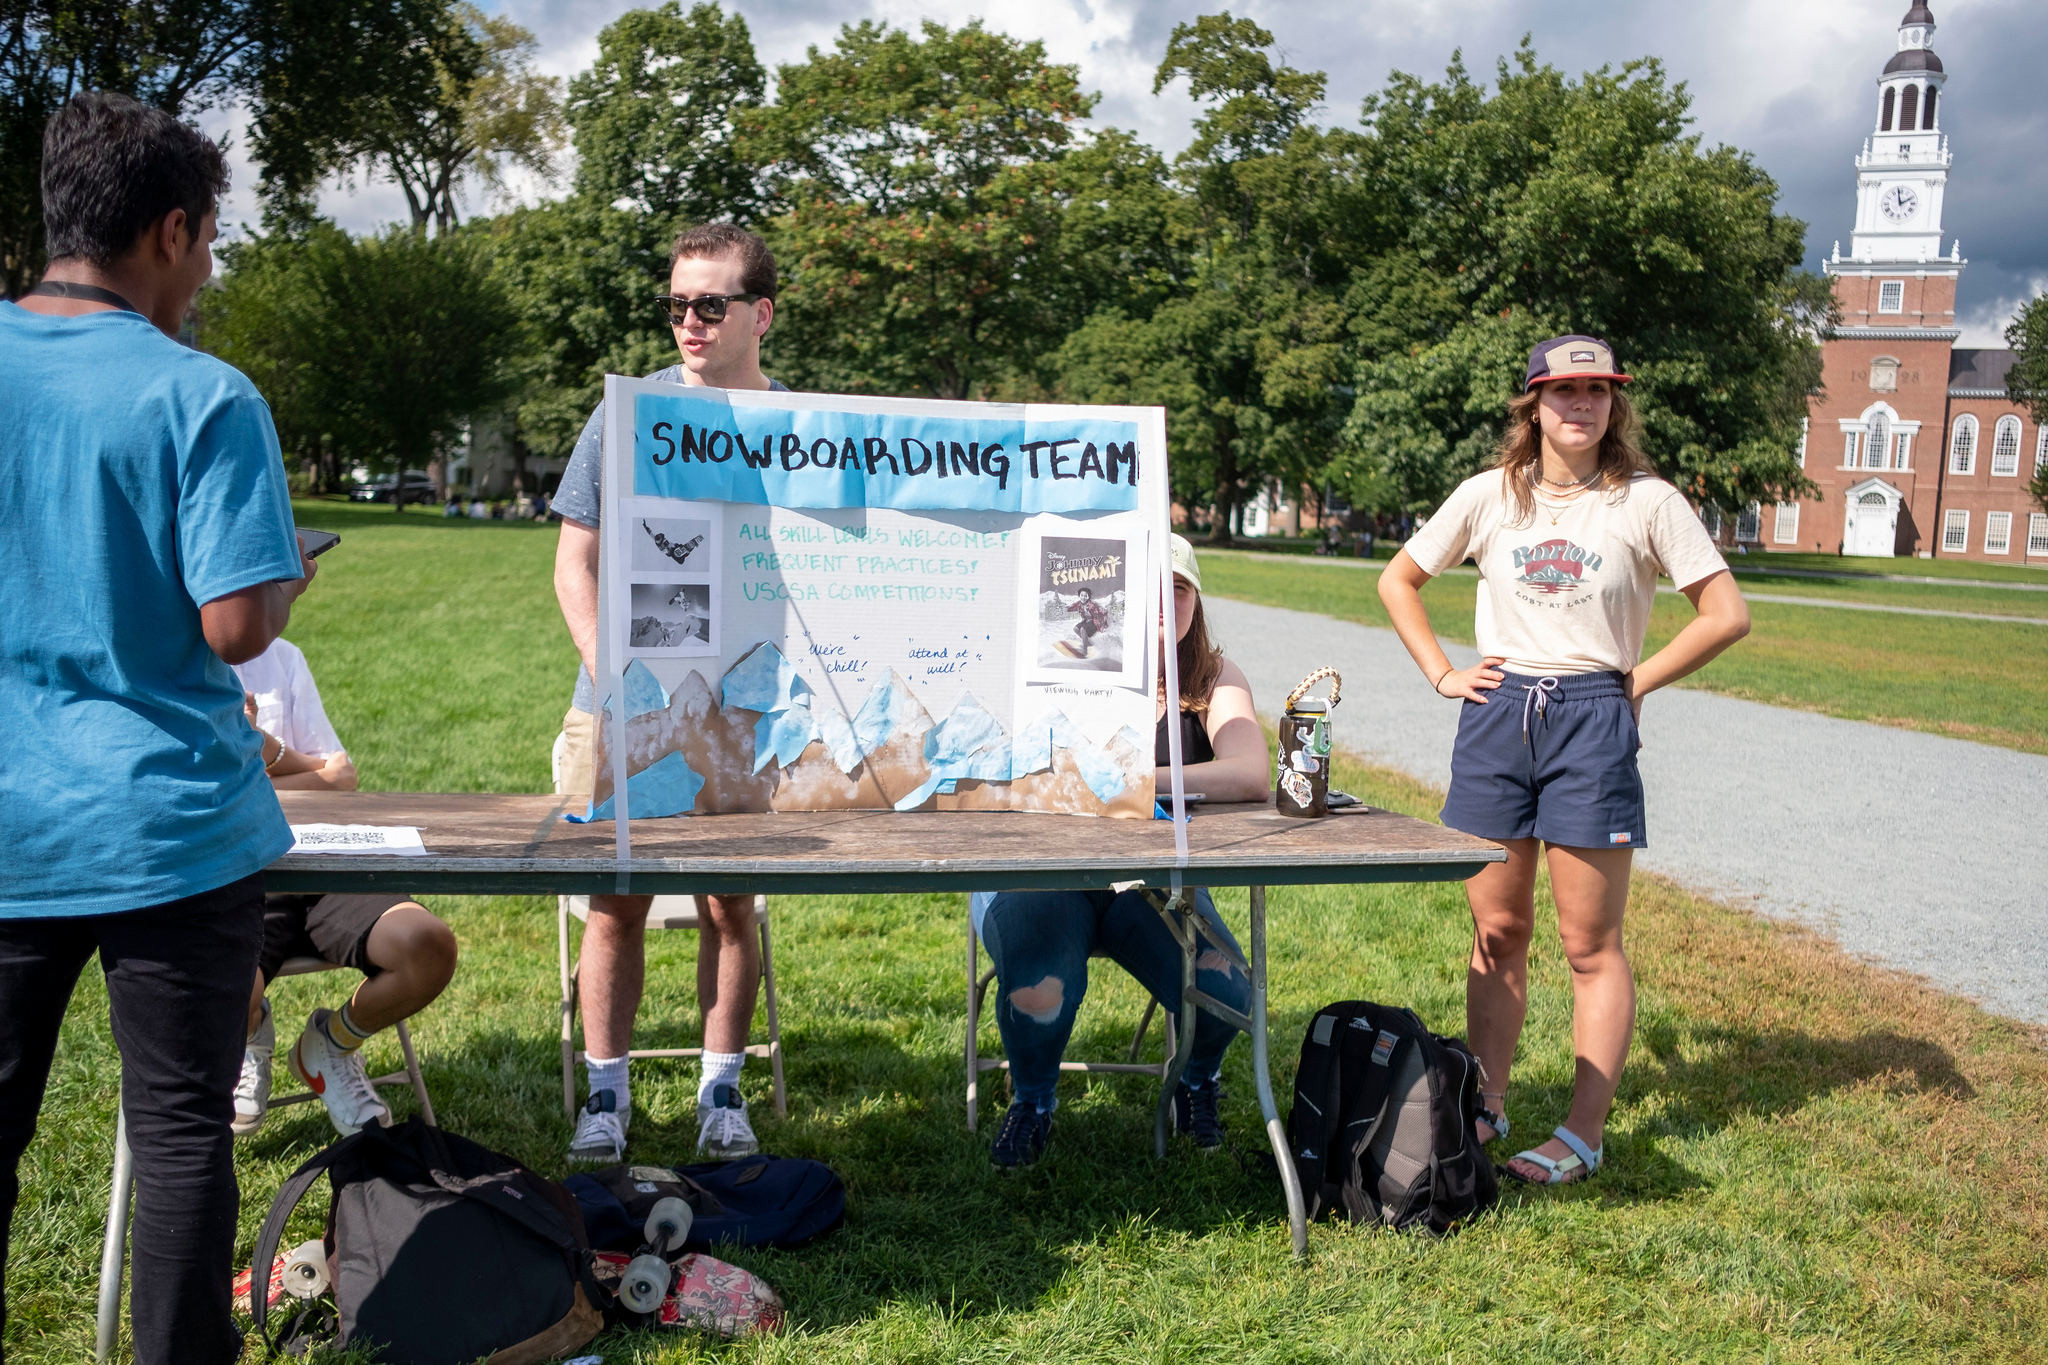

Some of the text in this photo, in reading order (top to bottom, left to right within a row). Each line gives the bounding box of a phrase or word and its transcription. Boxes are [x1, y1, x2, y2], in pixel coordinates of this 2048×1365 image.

[653, 421, 1139, 489] SNOWBOARDING TEAM
[739, 523, 1010, 549] ALL SKILL LEVELS WELCOME!
[742, 551, 979, 575] FREQUENT PRACTICES!
[1051, 556, 1122, 586] TSUNAMI
[743, 582, 979, 602] USCSA COMPETITIONS!
[1514, 590, 1544, 607] LOST
[1566, 593, 1594, 608] LAST
[908, 647, 970, 659] attend at
[826, 660, 869, 674] chill!
[927, 661, 968, 675] will!
[1044, 686, 1113, 697] VIEWING PARTY!
